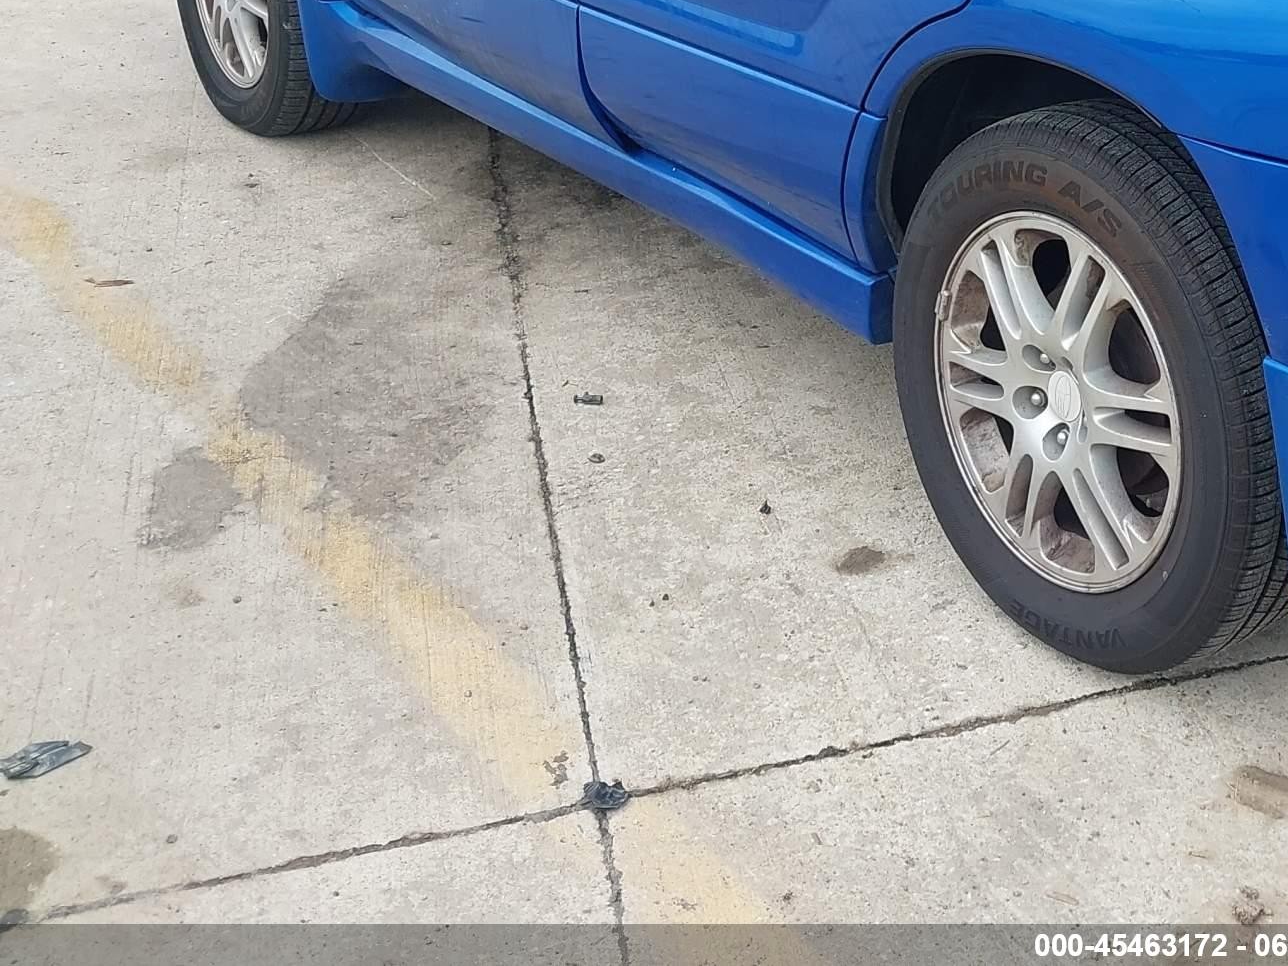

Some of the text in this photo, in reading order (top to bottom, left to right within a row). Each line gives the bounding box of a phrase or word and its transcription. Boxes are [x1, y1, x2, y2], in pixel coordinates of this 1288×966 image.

[927, 160, 1122, 238] TOURING A/S
[1008, 599, 1127, 649] VANTAGE
